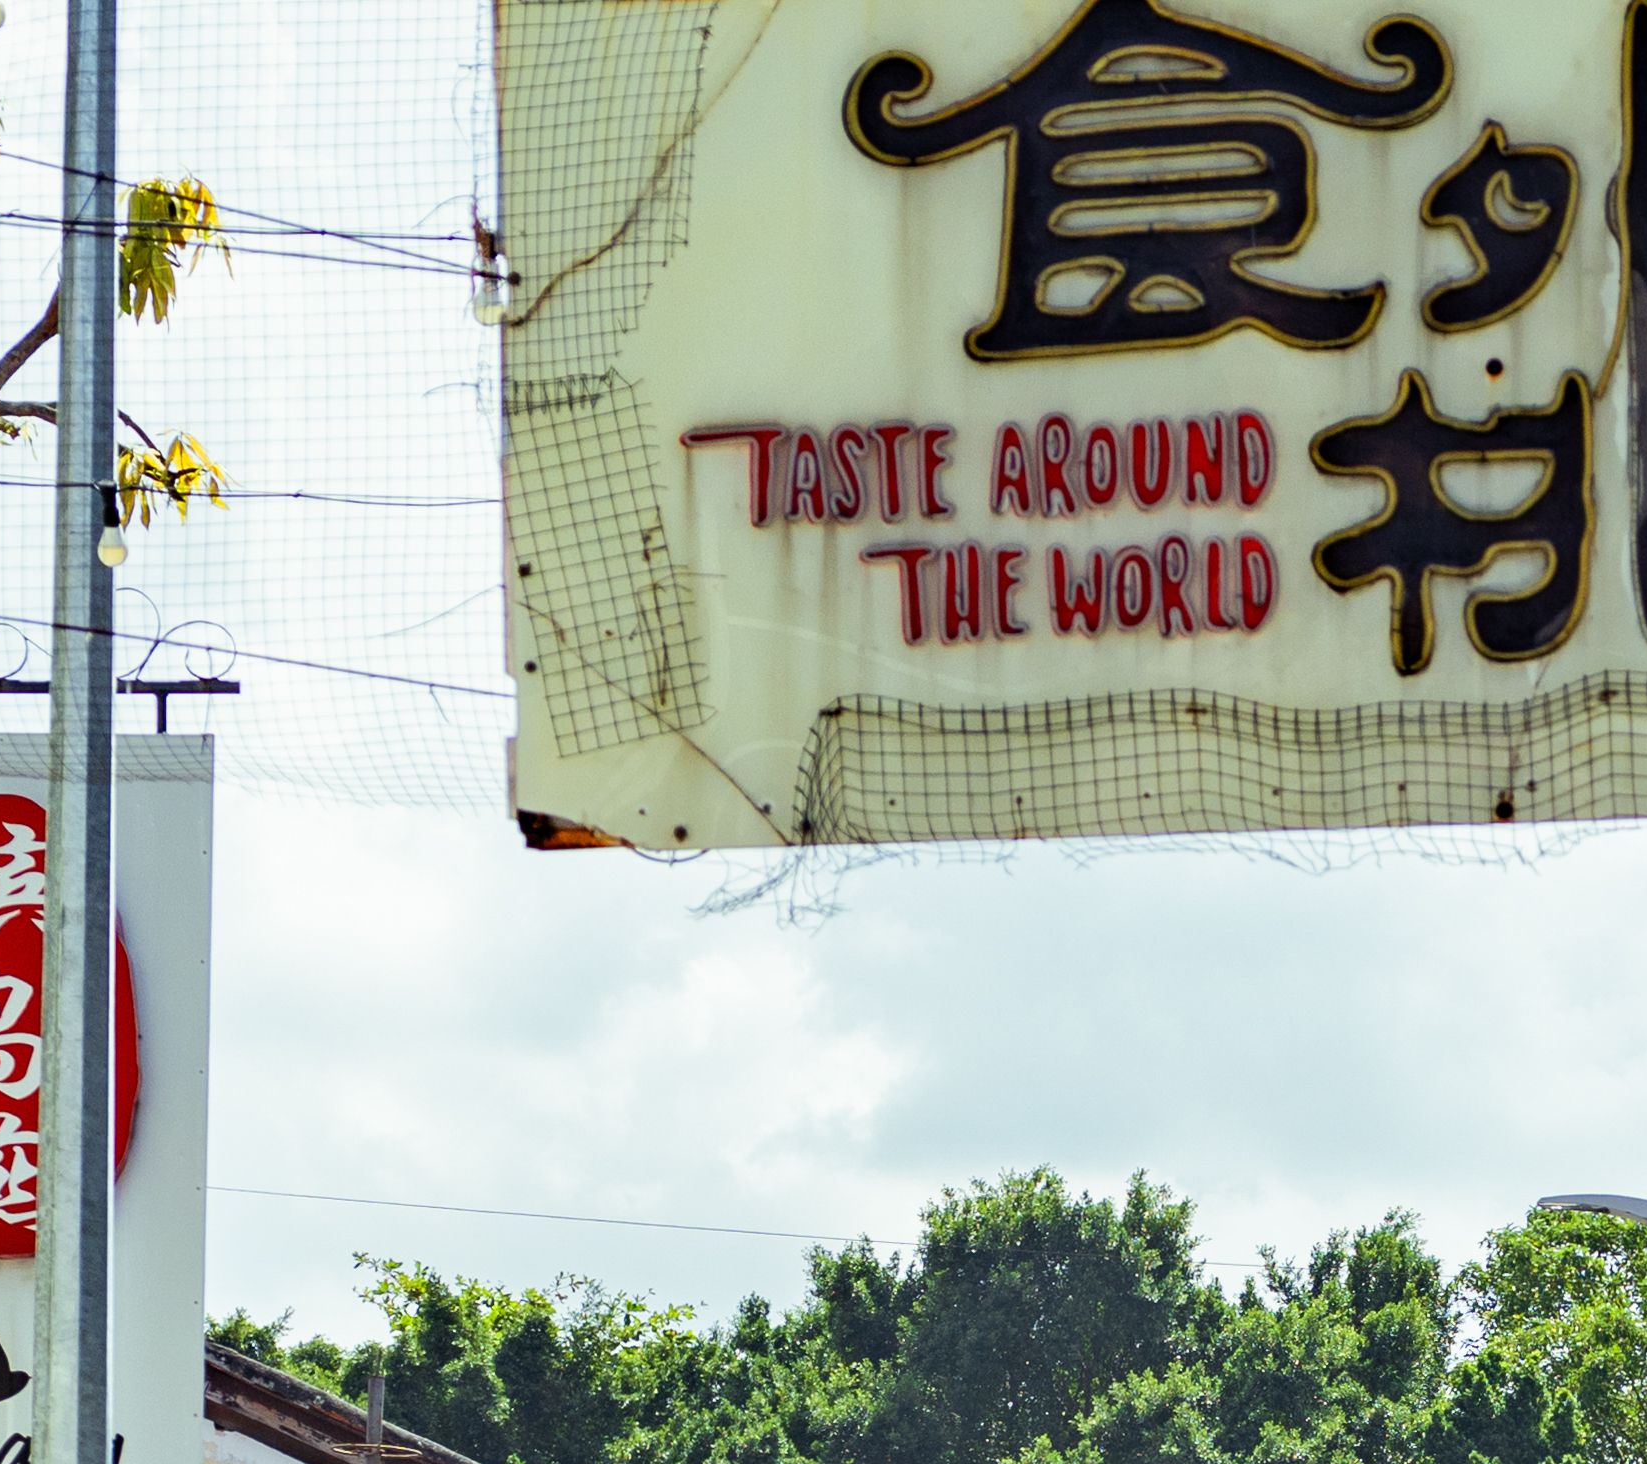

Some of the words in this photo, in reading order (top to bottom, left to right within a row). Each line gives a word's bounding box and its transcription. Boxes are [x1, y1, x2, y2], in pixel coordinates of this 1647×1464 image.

[683, 422, 950, 526] TASTE
[993, 409, 1276, 514] AROUND
[864, 541, 1027, 645] THE
[1049, 533, 1276, 638] WORLD
